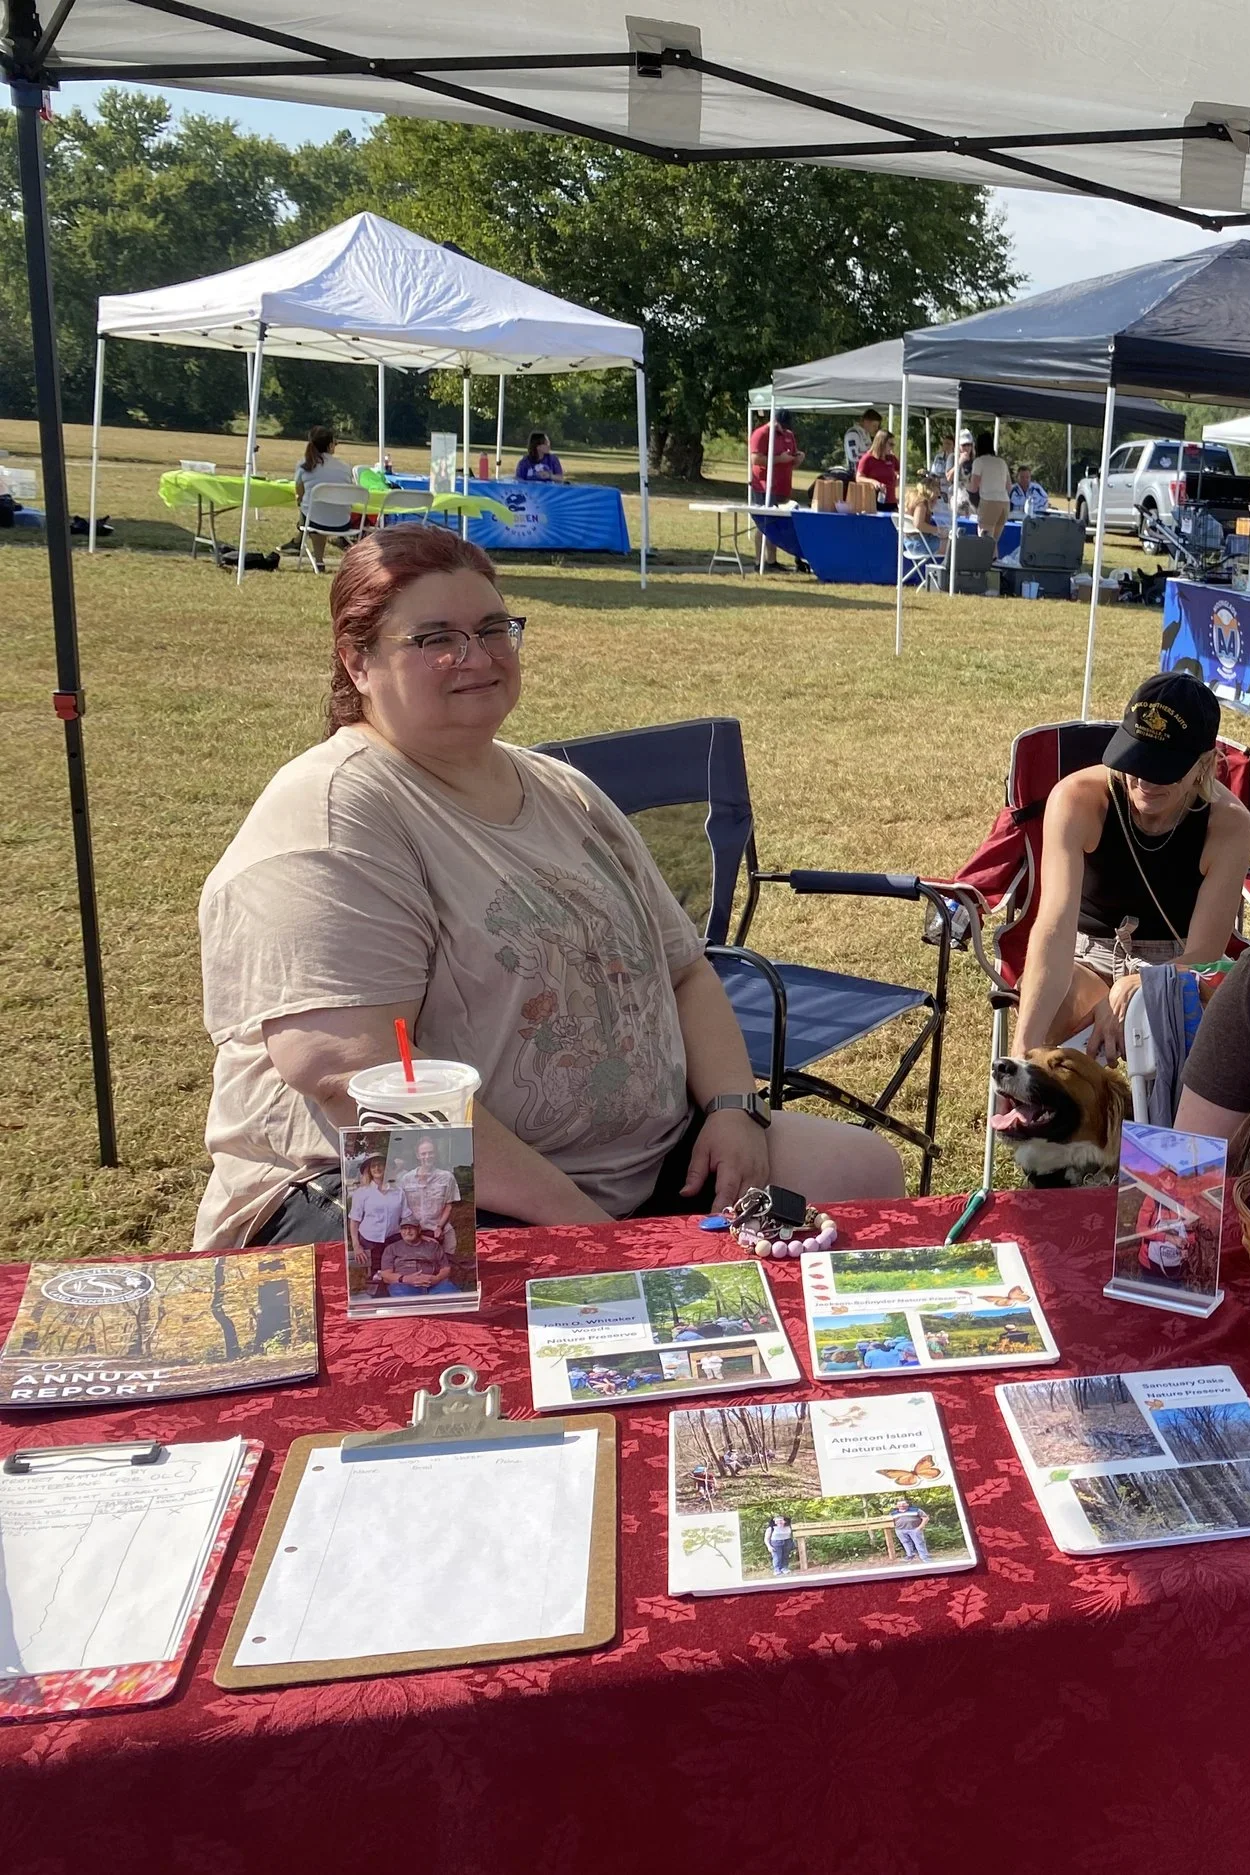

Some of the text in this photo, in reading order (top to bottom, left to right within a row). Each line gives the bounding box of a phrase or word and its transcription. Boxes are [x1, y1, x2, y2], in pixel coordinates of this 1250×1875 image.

[1174, 714, 1188, 729] AUTO
[897, 1296, 928, 1304] Nature
[586, 1316, 636, 1325] Whitaker
[547, 1331, 637, 1344] Nature Preserve
[16, 1361, 106, 1373] 2024
[13, 1370, 171, 1386] ANNUAL
[1142, 1380, 1195, 1389] Sanctuary
[10, 1381, 161, 1399] REPORT
[1147, 1387, 1232, 1399] Nature Preserve
[832, 1430, 923, 1444] Atherton Island
[842, 1441, 917, 1454] Natural Area
[0, 1471, 186, 1492] OLUNTEERING FOR OLC
[1, 1468, 150, 1485] PROTECT NATURE BY
[62, 1493, 103, 1502] PRINT
